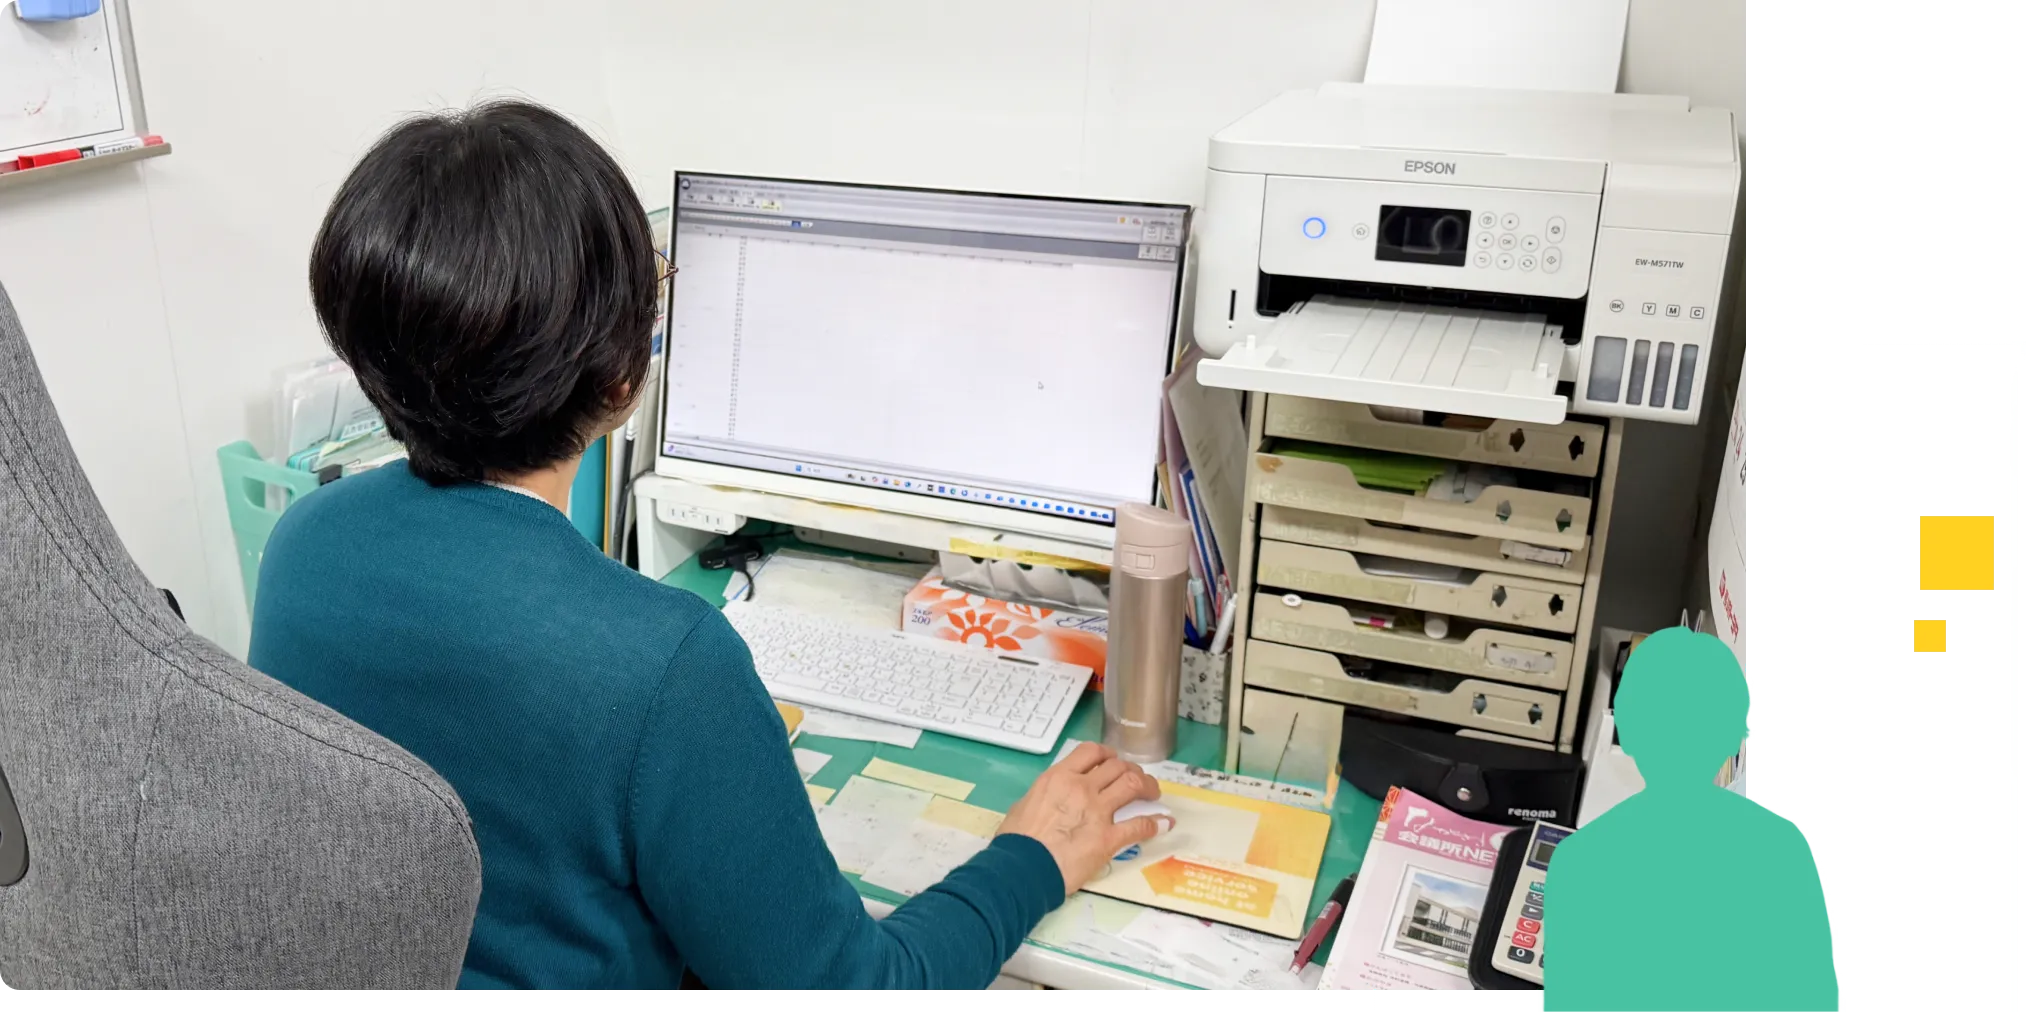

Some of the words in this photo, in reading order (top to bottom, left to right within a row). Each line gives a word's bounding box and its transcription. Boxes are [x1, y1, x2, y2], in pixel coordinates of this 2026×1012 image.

[1404, 160, 1456, 175] EPSON
[1635, 258, 1684, 269] EW-M571TW
[911, 615, 931, 626] 200
[1508, 807, 1557, 819] renoma
[1183, 869, 1258, 893] service
[1173, 885, 1230, 905] home
[1187, 878, 1250, 899] online
[1515, 933, 1532, 943] AC
